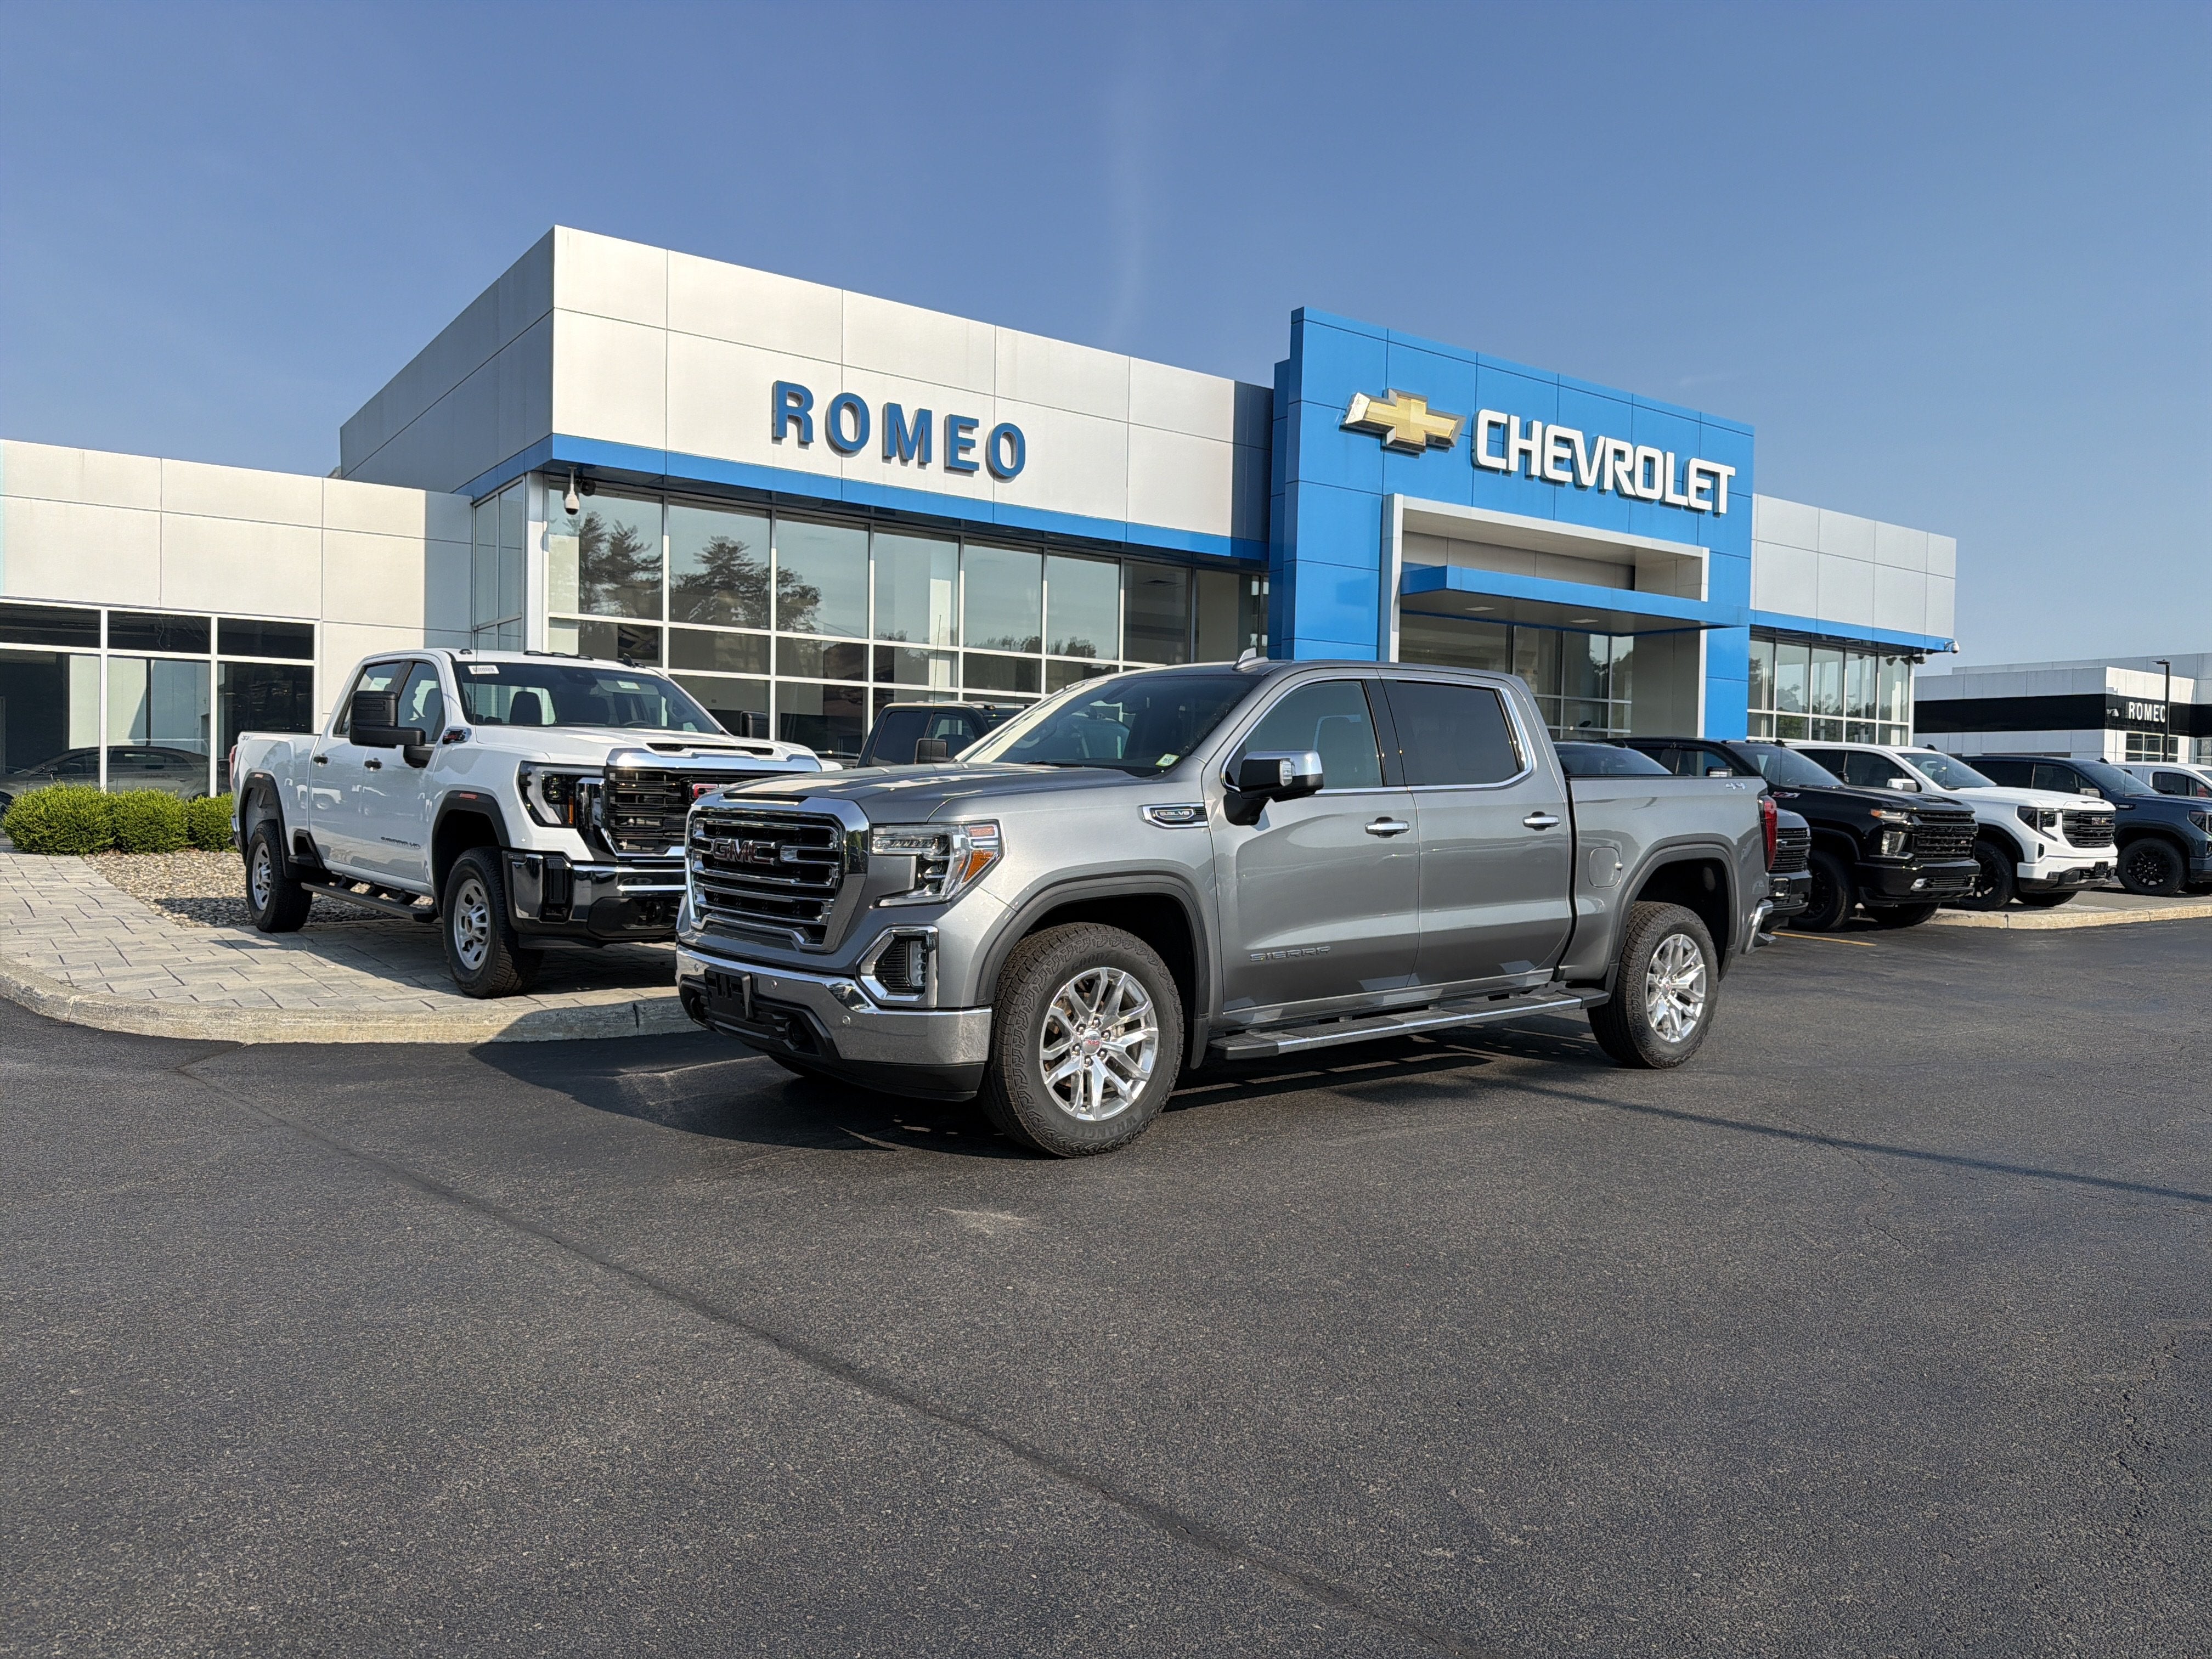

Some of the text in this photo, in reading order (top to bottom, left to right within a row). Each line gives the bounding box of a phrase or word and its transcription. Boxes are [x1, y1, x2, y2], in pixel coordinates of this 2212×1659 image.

[772, 380, 1026, 478] ROMEO
[1472, 409, 1736, 514] CHEVROLET
[2129, 701, 2165, 723] ROMEO
[714, 838, 776, 866] GMC
[1250, 946, 1330, 962] SIERRA
